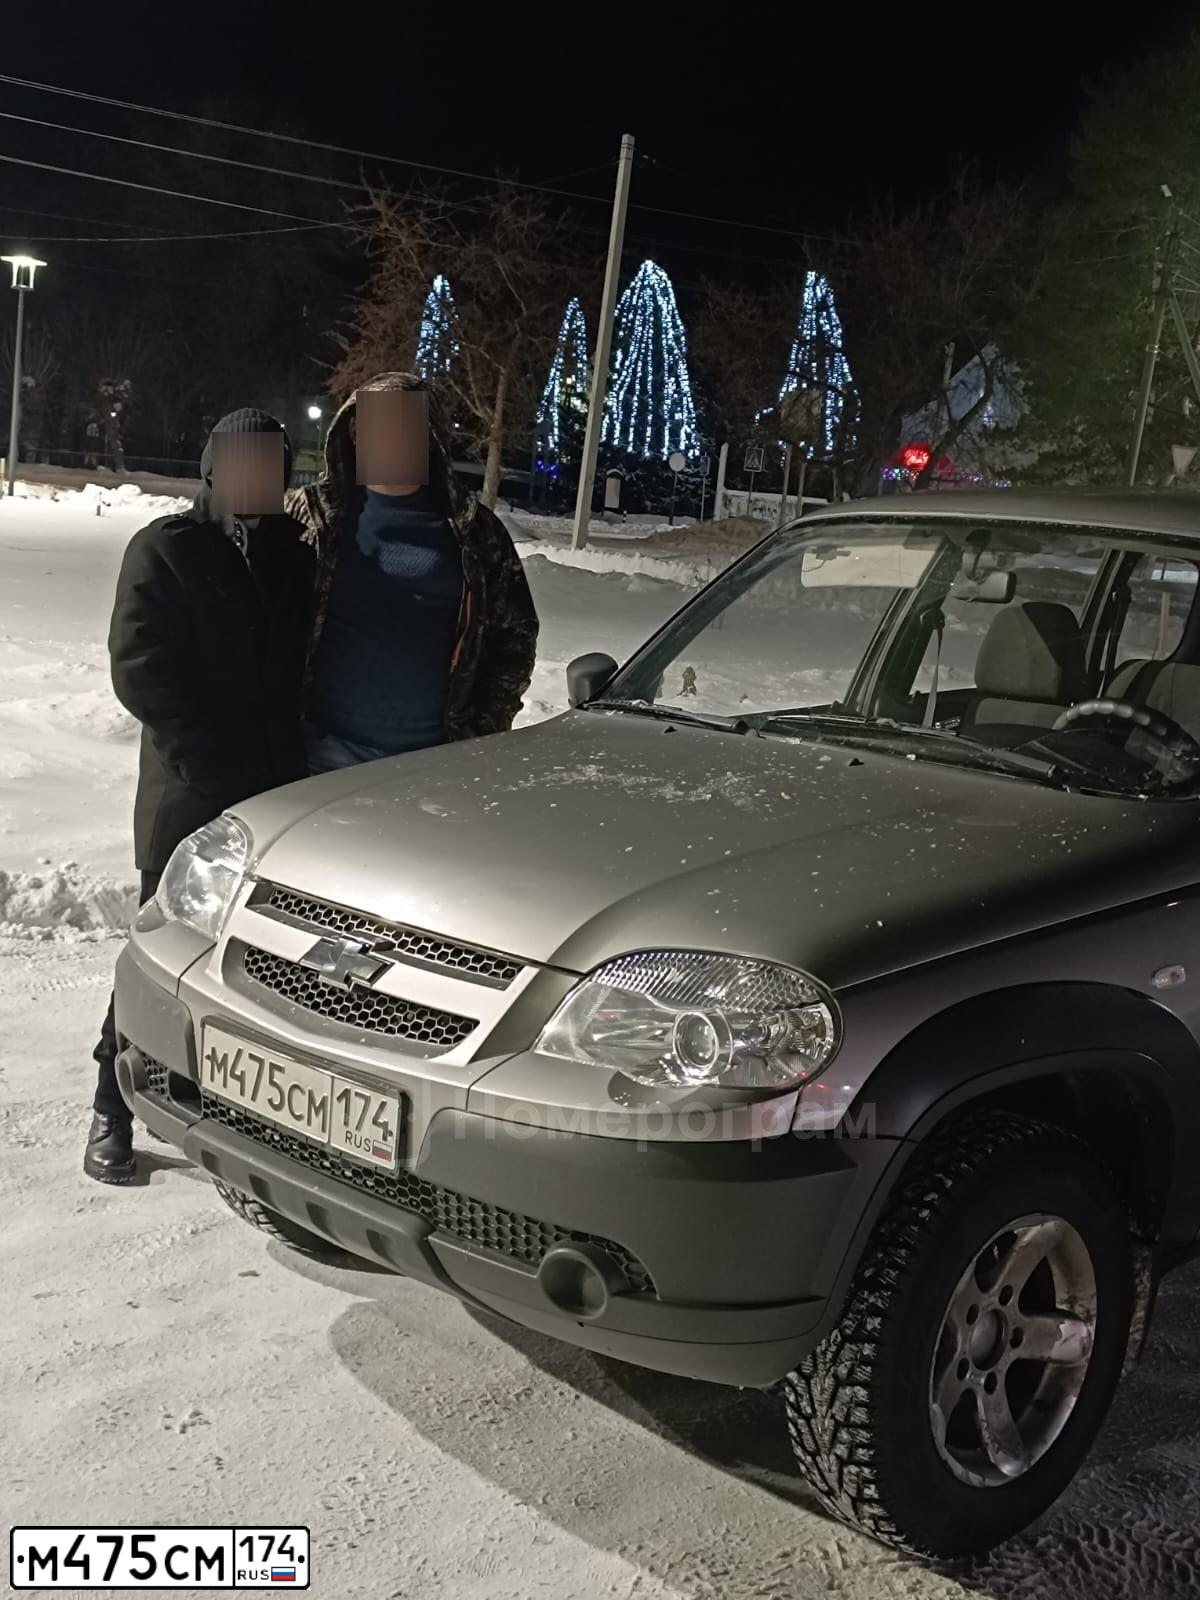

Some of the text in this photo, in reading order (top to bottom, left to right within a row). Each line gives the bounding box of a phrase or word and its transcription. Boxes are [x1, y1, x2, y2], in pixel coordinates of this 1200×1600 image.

[211, 1046, 390, 1142] М475СМ 174
[345, 1131, 371, 1153] RUS
